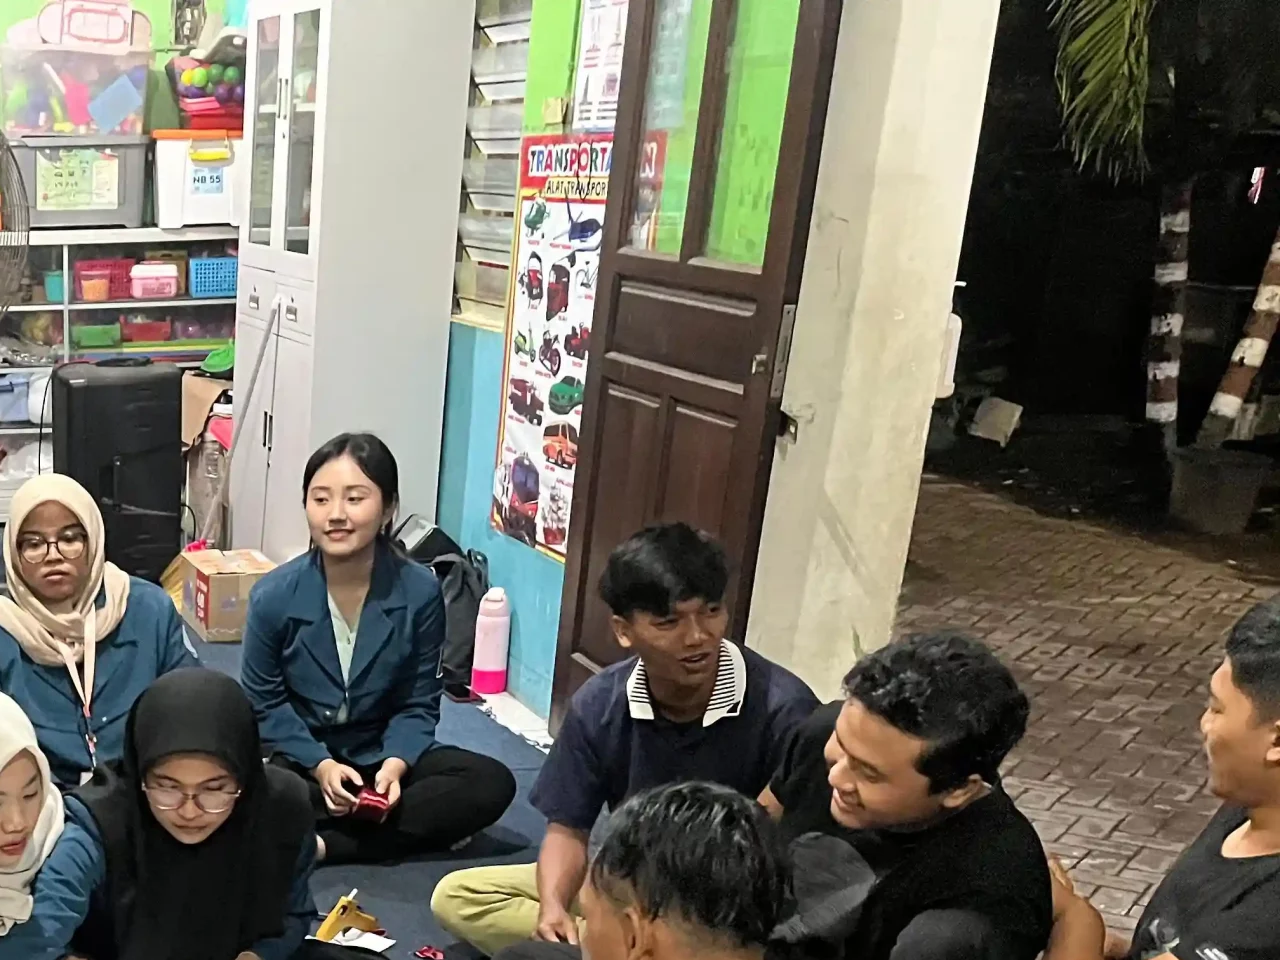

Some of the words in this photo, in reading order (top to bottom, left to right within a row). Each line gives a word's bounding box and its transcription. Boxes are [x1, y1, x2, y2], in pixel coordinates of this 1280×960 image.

[210, 175, 221, 184] 55
[547, 180, 565, 195] ALAT
[566, 181, 607, 196] TRANSPOR
